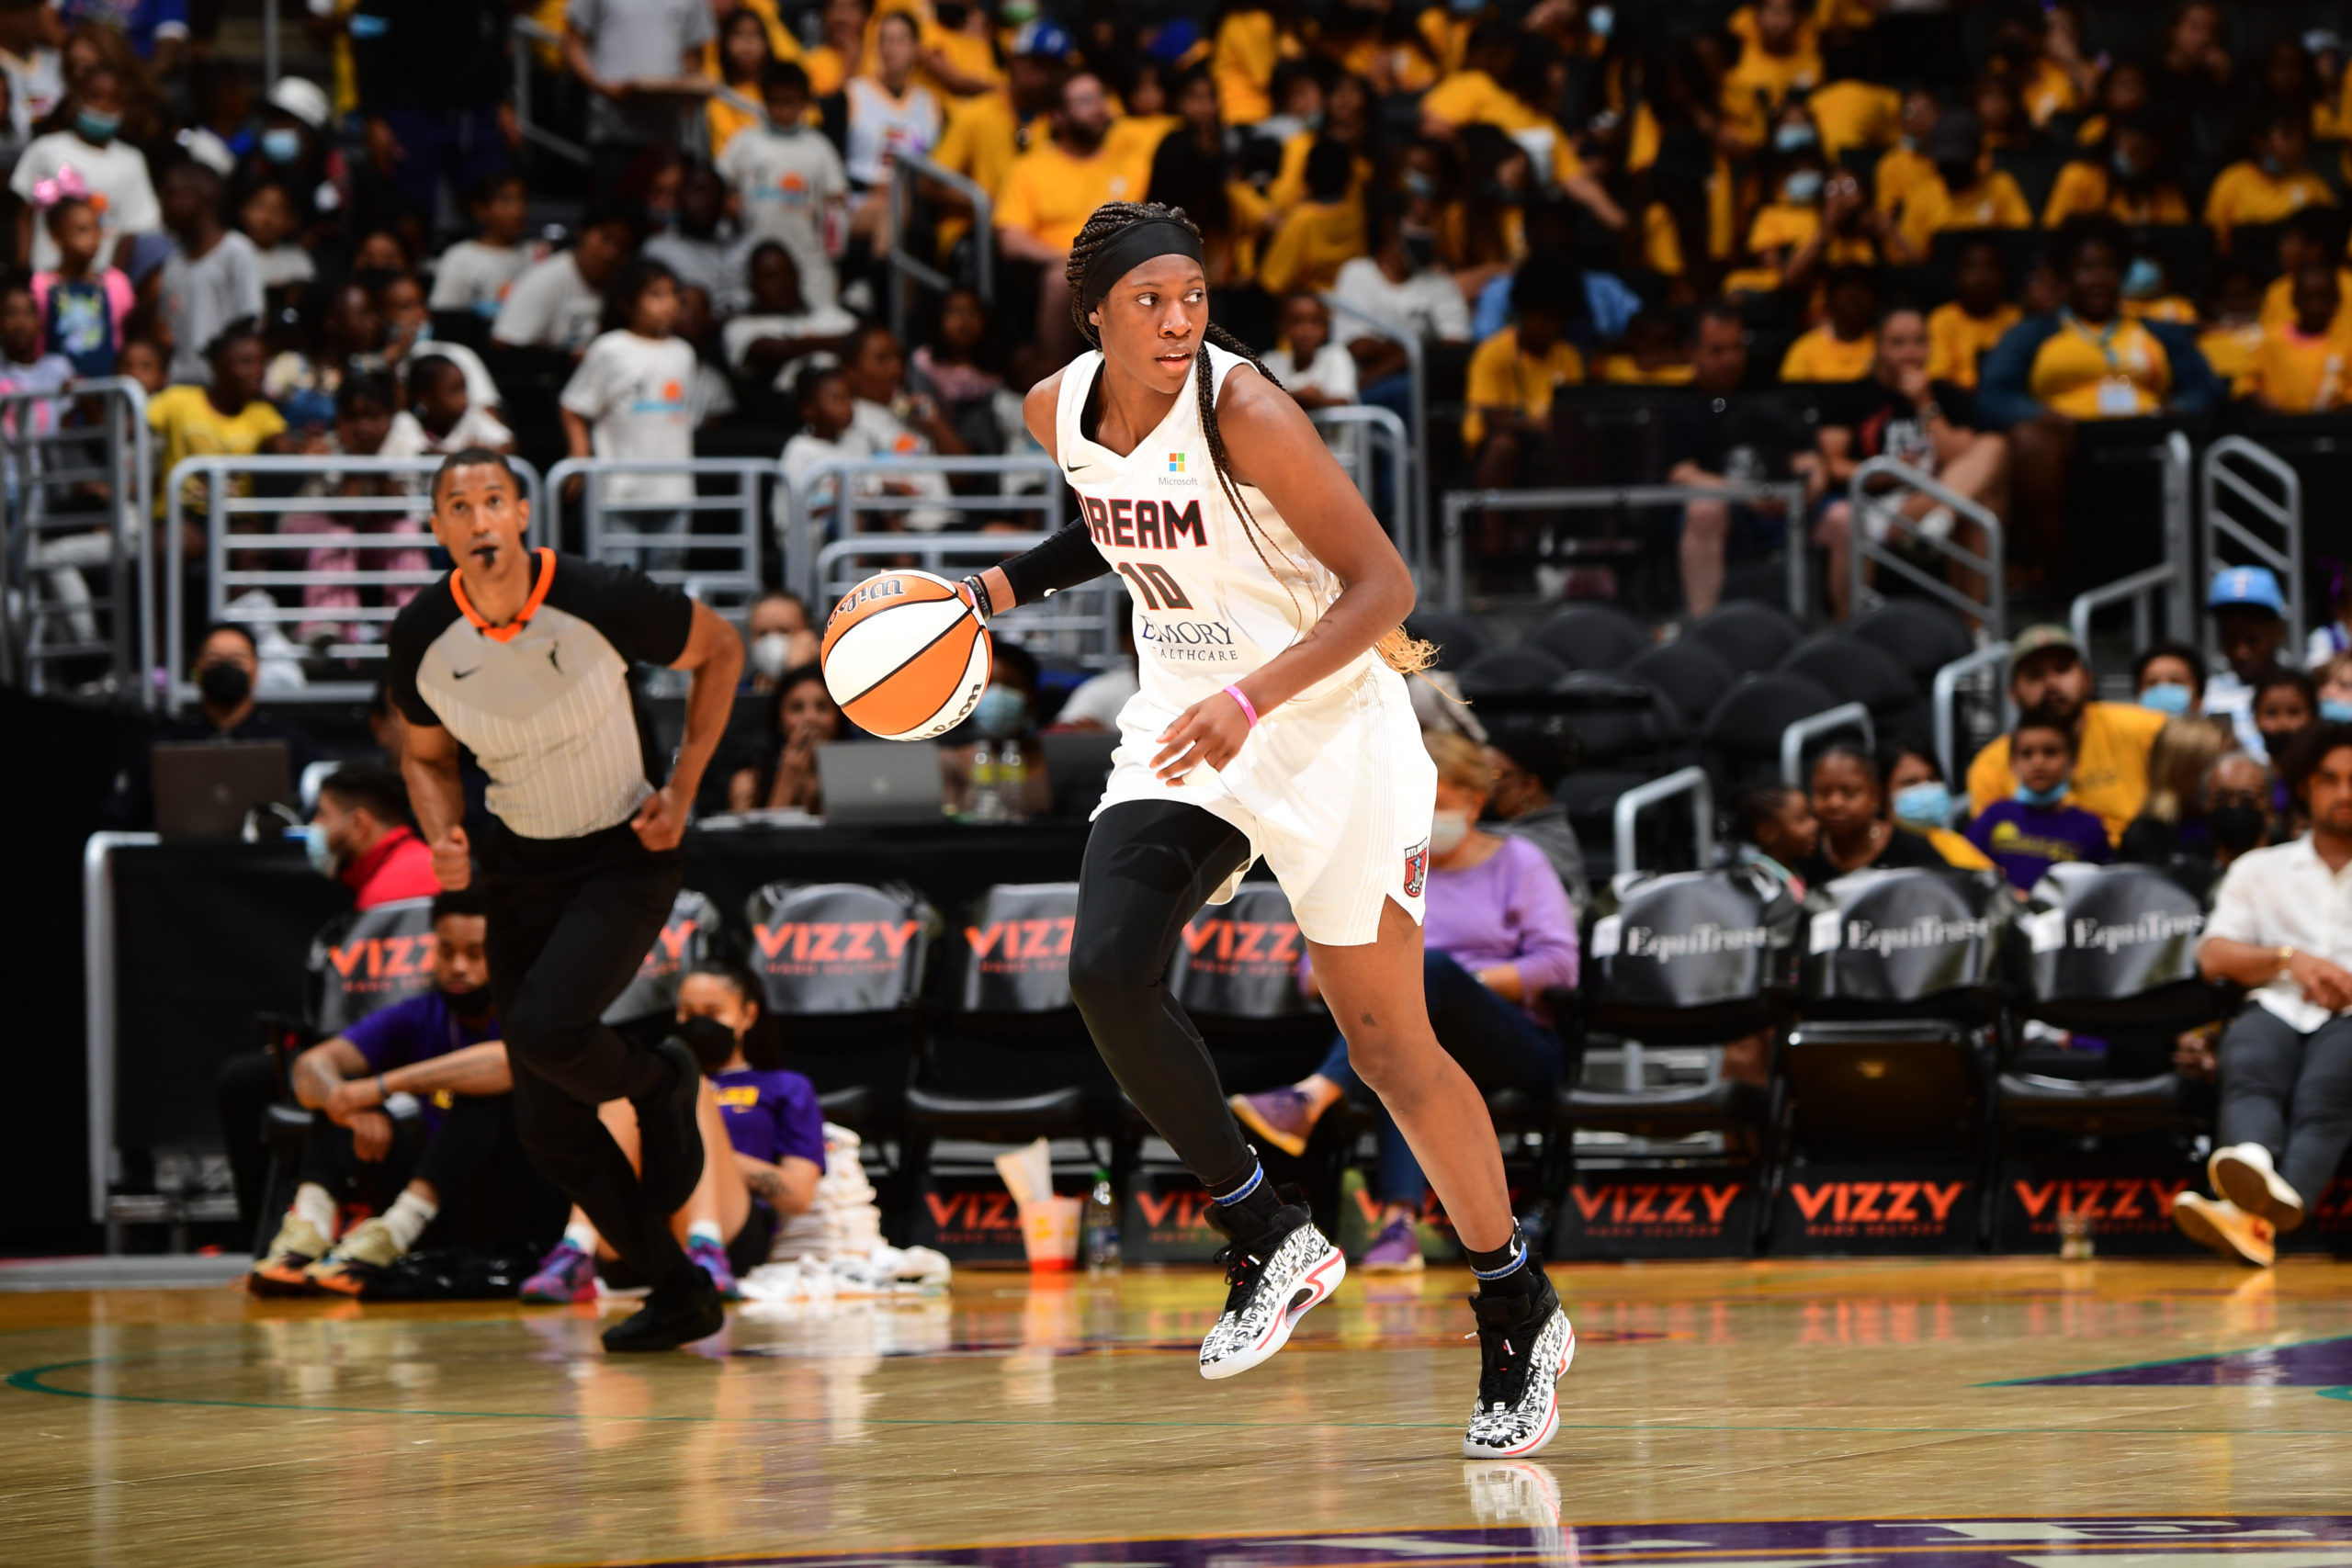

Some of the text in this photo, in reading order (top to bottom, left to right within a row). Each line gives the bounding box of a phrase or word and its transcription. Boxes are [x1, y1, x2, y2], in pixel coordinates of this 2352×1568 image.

[1159, 477, 1198, 485] Microsoft
[825, 579, 904, 635] Wilso
[1118, 562, 1193, 610] 10
[1152, 647, 1238, 661] ALTHCARE
[328, 931, 437, 978] VIZZ
[752, 919, 919, 961] VIZZY
[964, 917, 1076, 960] VIZZ
[1181, 918, 1300, 962] VIZZ
[1848, 916, 1989, 958] EquiTrust
[923, 1191, 1024, 1229] VIZ
[1136, 1190, 1215, 1229] VIZ
[1571, 1183, 1743, 1224] VIZZY
[1791, 1181, 1964, 1223] VIZZY
[2014, 1179, 2188, 1218] VIZZY
